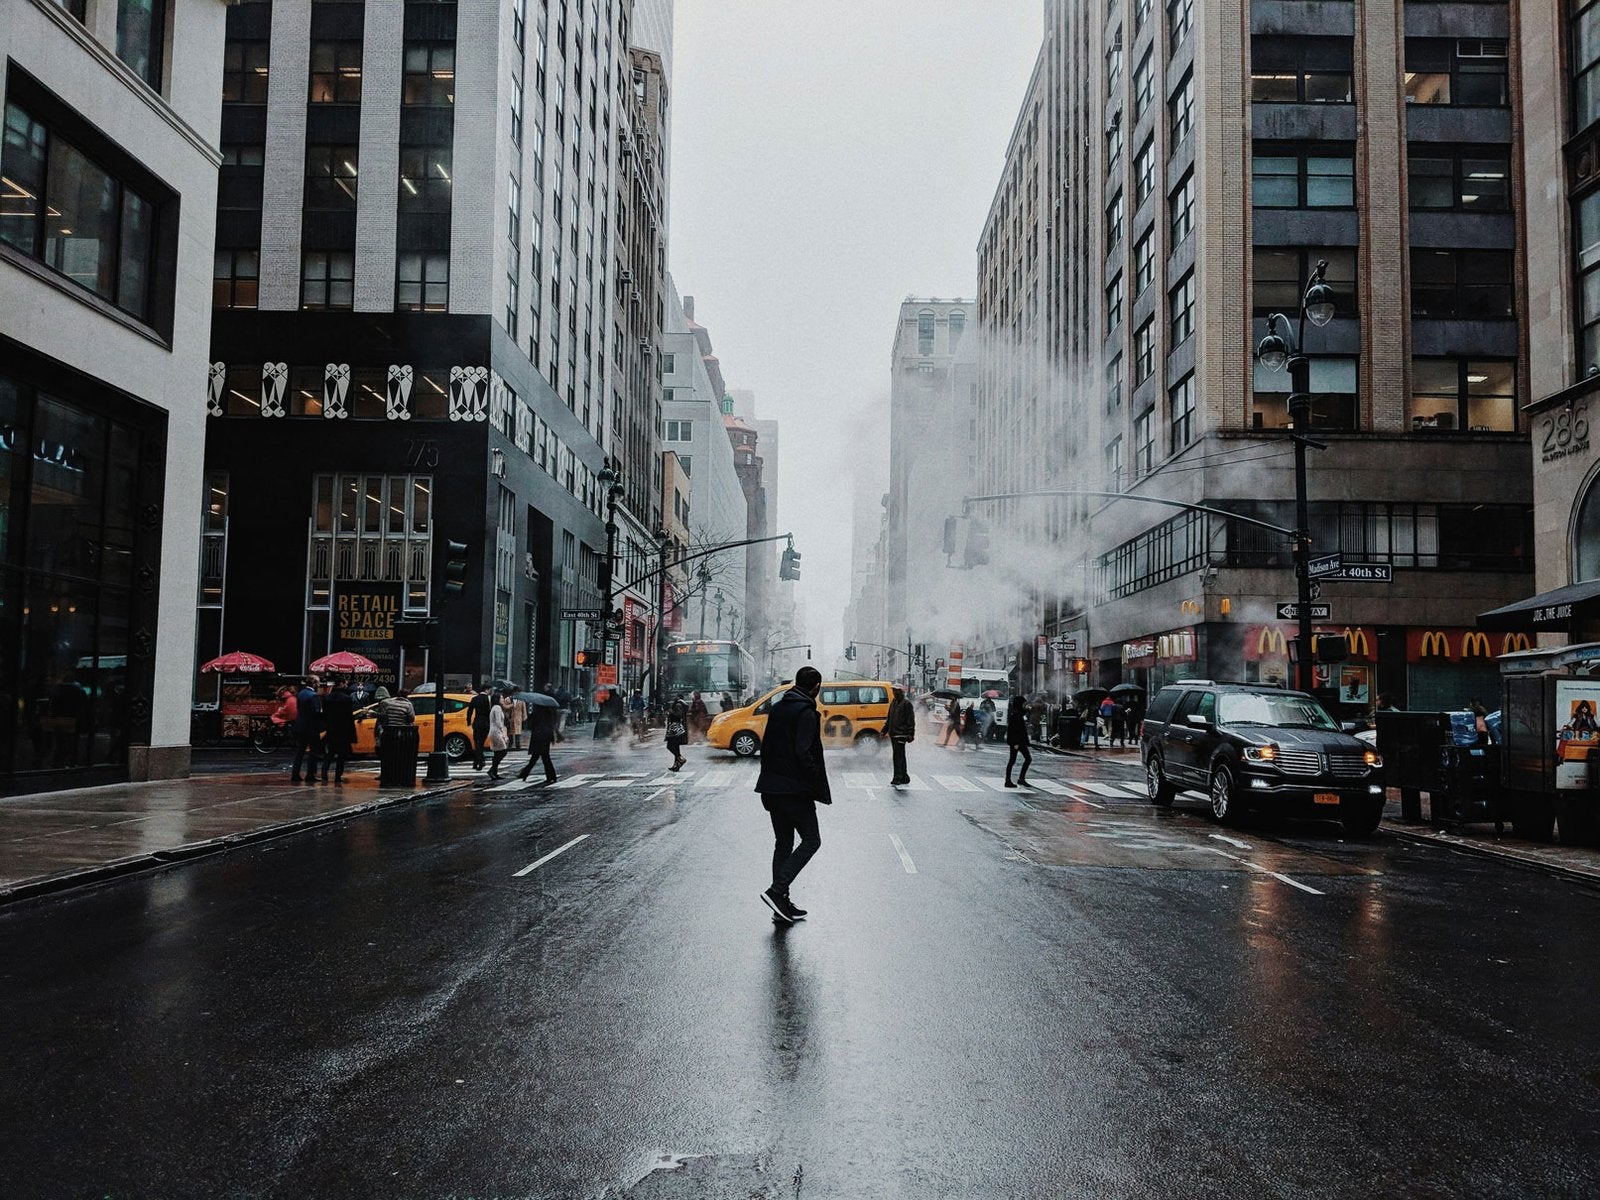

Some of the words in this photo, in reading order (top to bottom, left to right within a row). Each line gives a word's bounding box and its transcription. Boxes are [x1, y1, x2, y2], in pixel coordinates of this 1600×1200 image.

[1542, 405, 1589, 453] 286
[1309, 562, 1329, 575] Madison
[1330, 559, 1340, 570] Ave
[1349, 567, 1372, 578] 40th
[1374, 567, 1387, 578] St
[338, 594, 398, 611] RETAIL
[1284, 607, 1299, 615] ONE
[1546, 607, 1556, 620] THE
[339, 611, 396, 629] SPACE
[345, 630, 360, 638] FOR
[363, 630, 390, 638] LEASE
